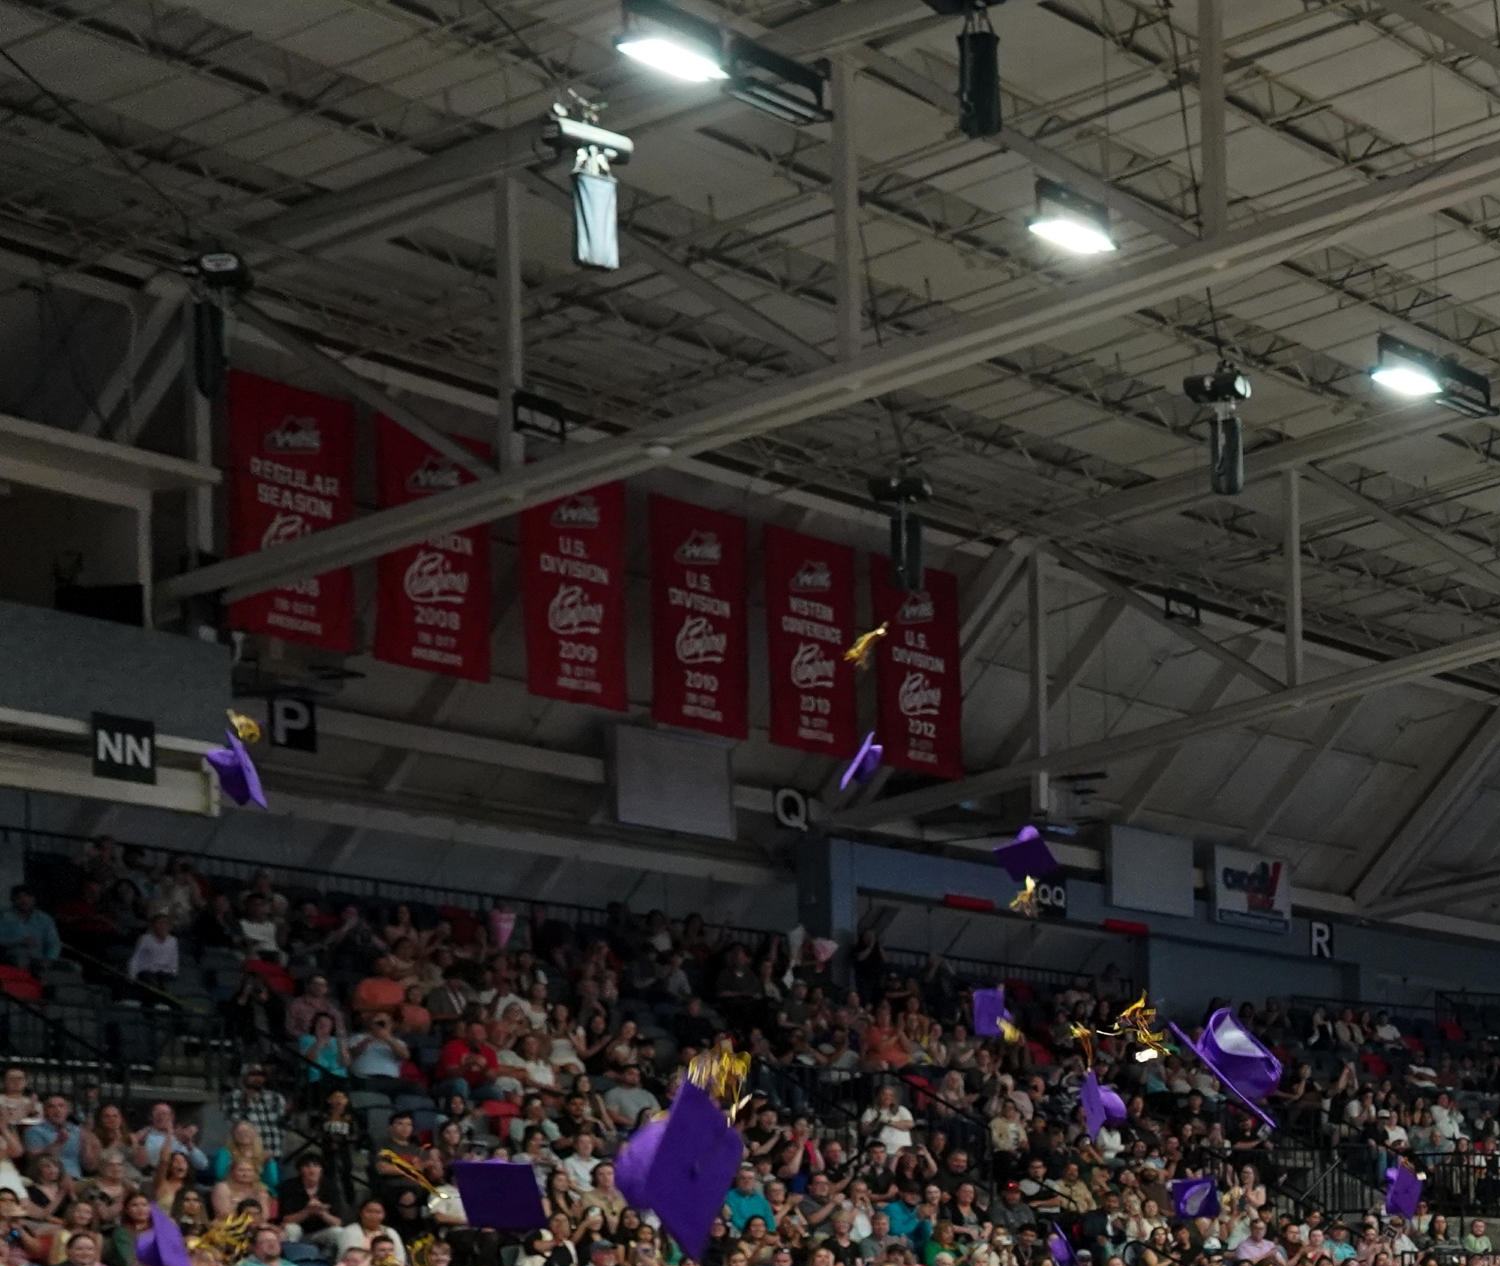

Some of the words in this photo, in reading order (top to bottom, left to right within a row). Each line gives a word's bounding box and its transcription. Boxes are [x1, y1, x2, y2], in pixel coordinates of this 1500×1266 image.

[250, 456, 340, 497] REGULAR
[258, 482, 333, 520] SEASON
[540, 552, 609, 586] DIVISION
[415, 603, 461, 631] 2008
[668, 587, 731, 619] DIVISION
[892, 646, 946, 674] DIVISION
[273, 699, 311, 744] P
[97, 729, 151, 768] NN
[776, 788, 808, 832] Q
[1037, 883, 1067, 908] QQ
[1312, 921, 1333, 959] R
